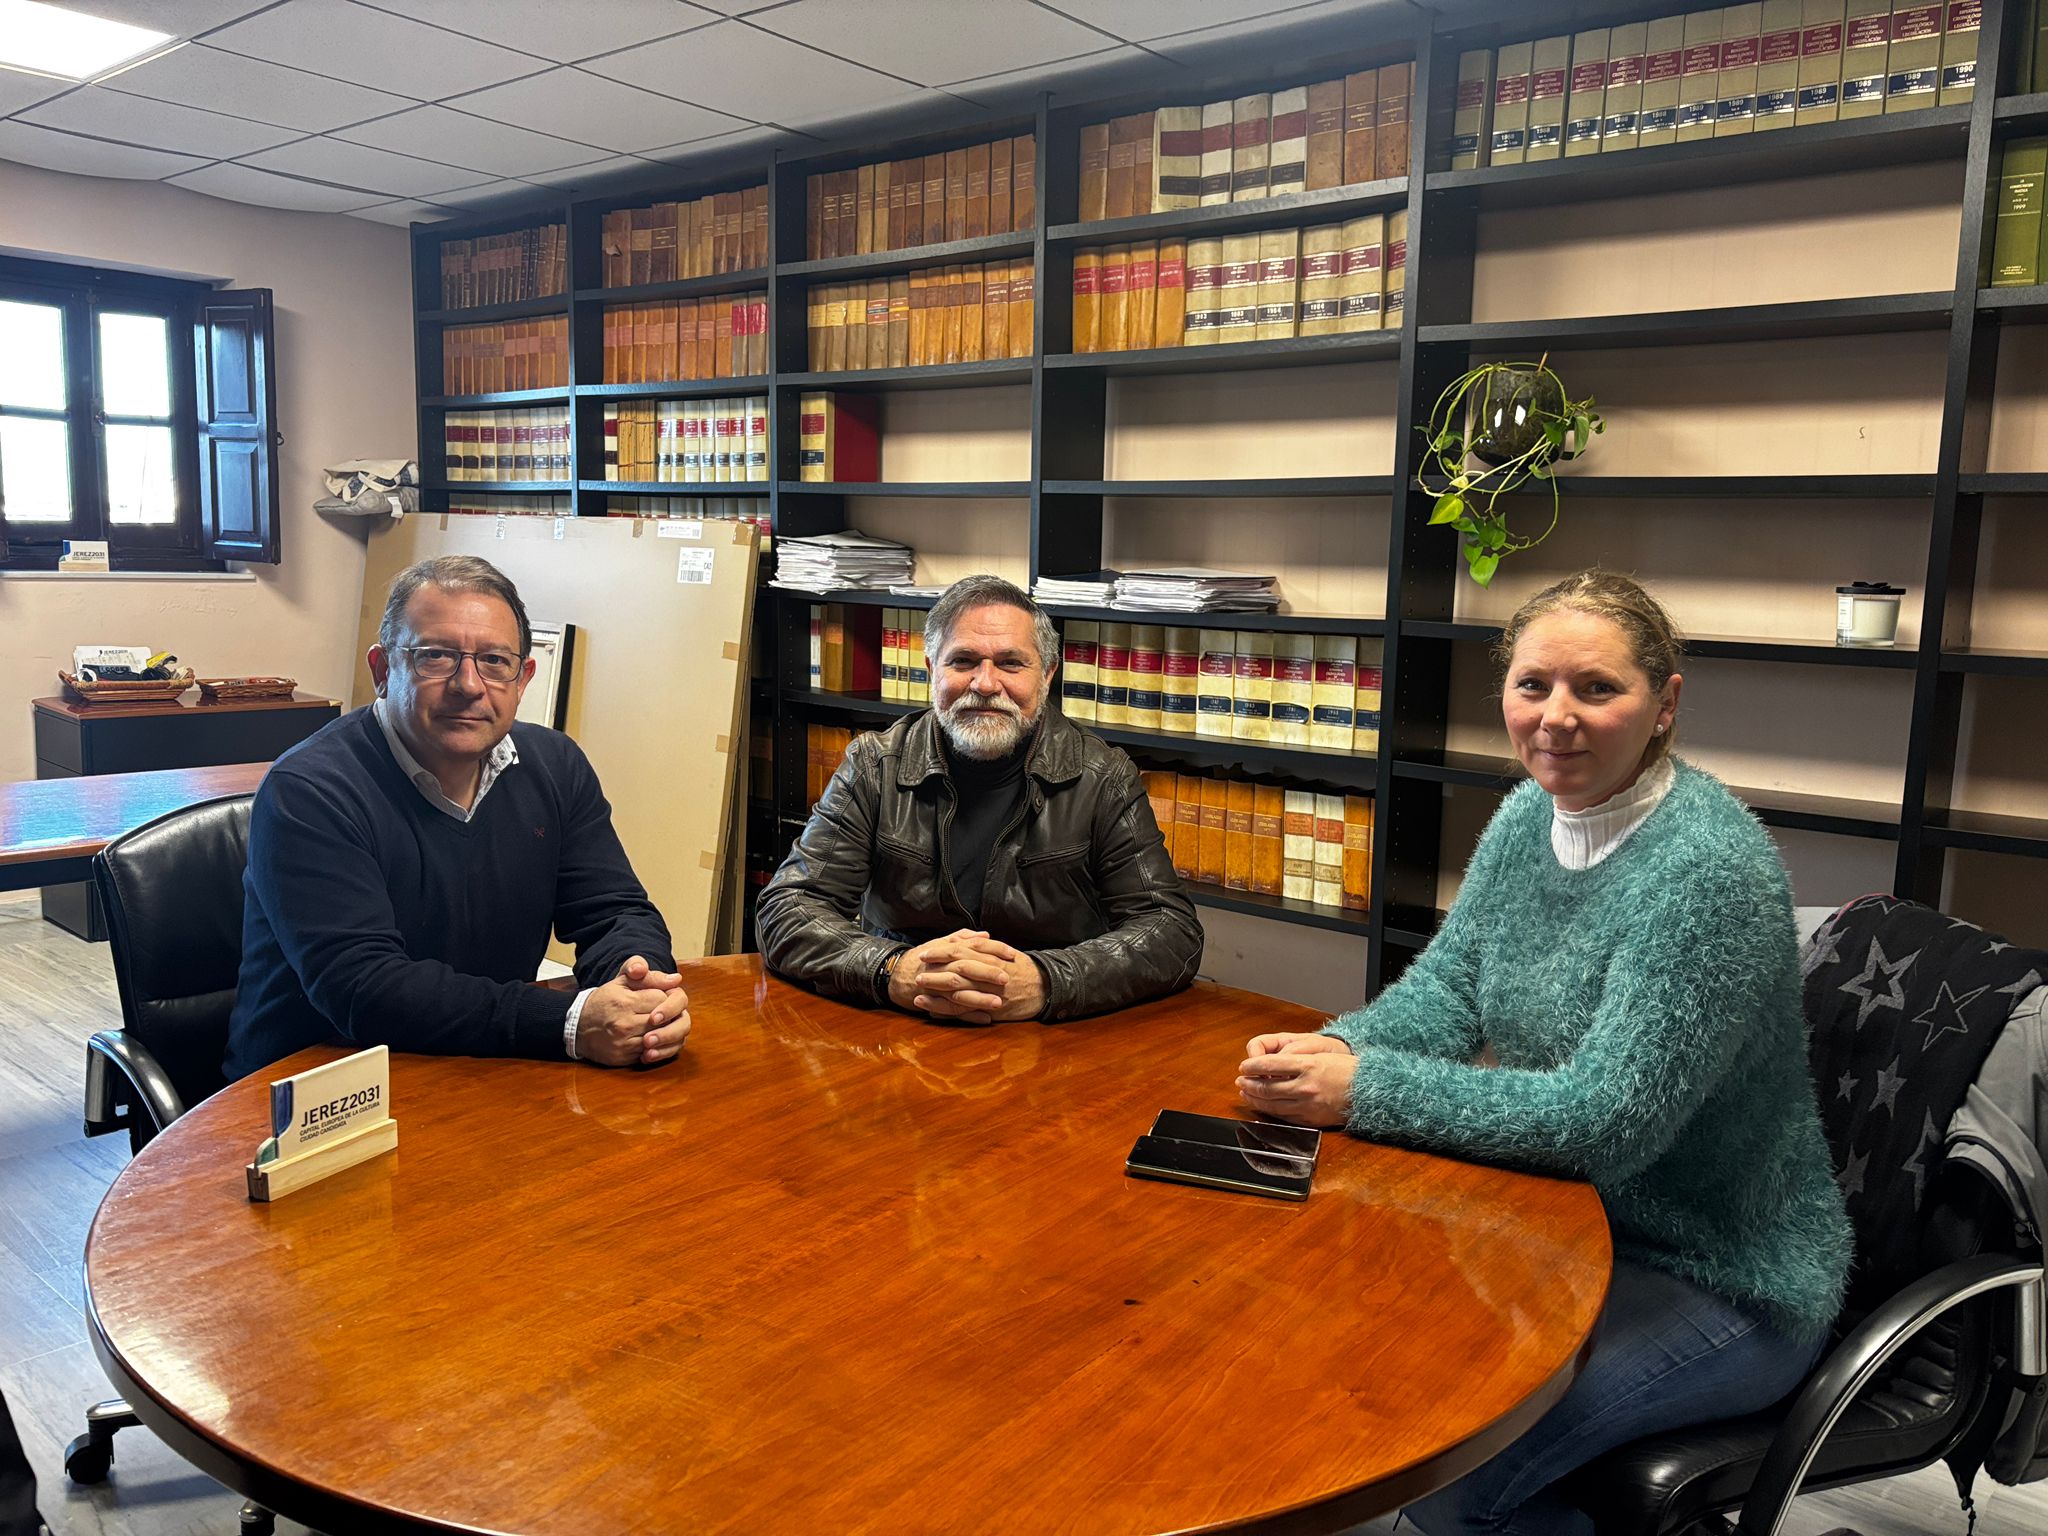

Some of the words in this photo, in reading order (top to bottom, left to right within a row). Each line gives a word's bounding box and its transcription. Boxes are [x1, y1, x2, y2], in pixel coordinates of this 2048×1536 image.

[1956, 65, 1974, 74] 1990
[1904, 72, 1921, 81] 1989
[1855, 79, 1872, 88] 1989
[1811, 87, 1827, 96] 1989
[1769, 92, 1784, 101] 1989
[1728, 99, 1744, 107] 1989
[301, 1085, 380, 1127] JEREZ2031
[300, 1124, 320, 1136] CAPITAL
[321, 1115, 344, 1128] EUROPEA
[359, 1101, 380, 1113] CULTURA
[300, 1131, 320, 1143] CIUDAD
[320, 1121, 347, 1135] CANDIDATA
